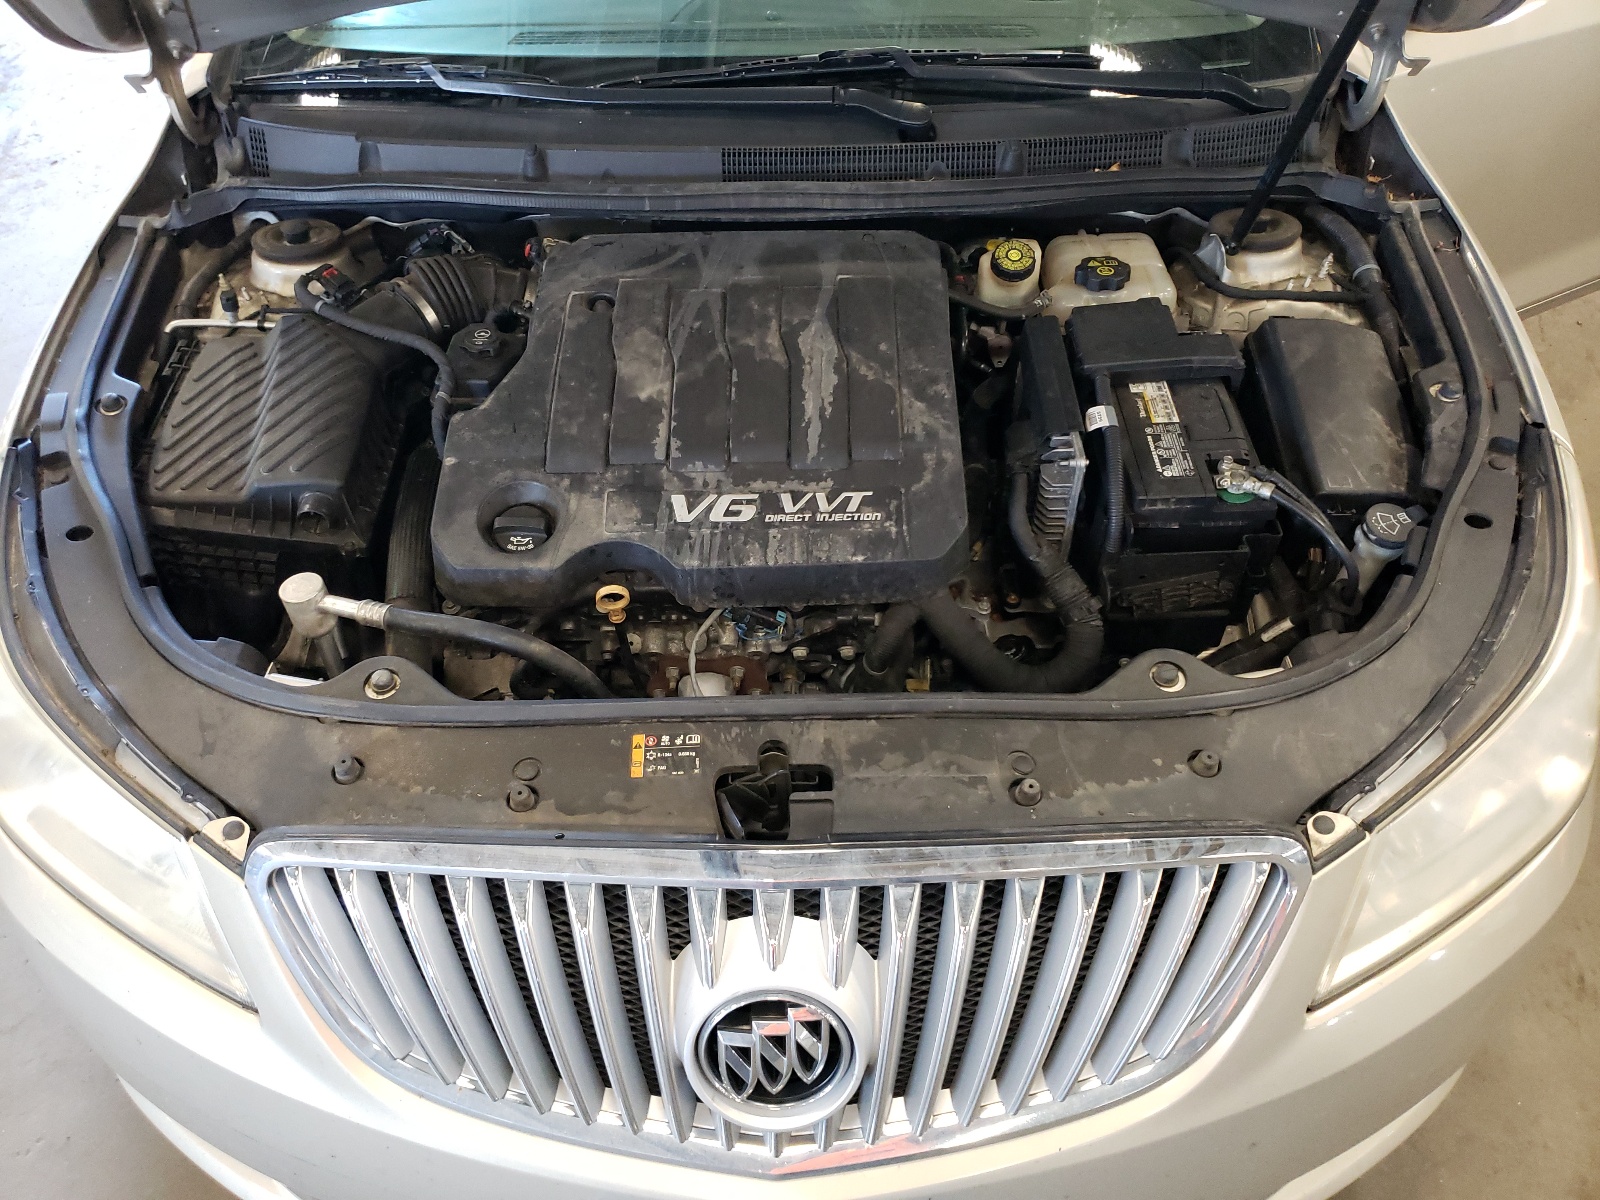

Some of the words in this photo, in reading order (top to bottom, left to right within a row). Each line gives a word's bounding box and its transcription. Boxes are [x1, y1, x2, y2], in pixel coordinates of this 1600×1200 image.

[670, 493, 760, 523] V6
[780, 491, 874, 513] VVT
[764, 513, 812, 522] DIRECT
